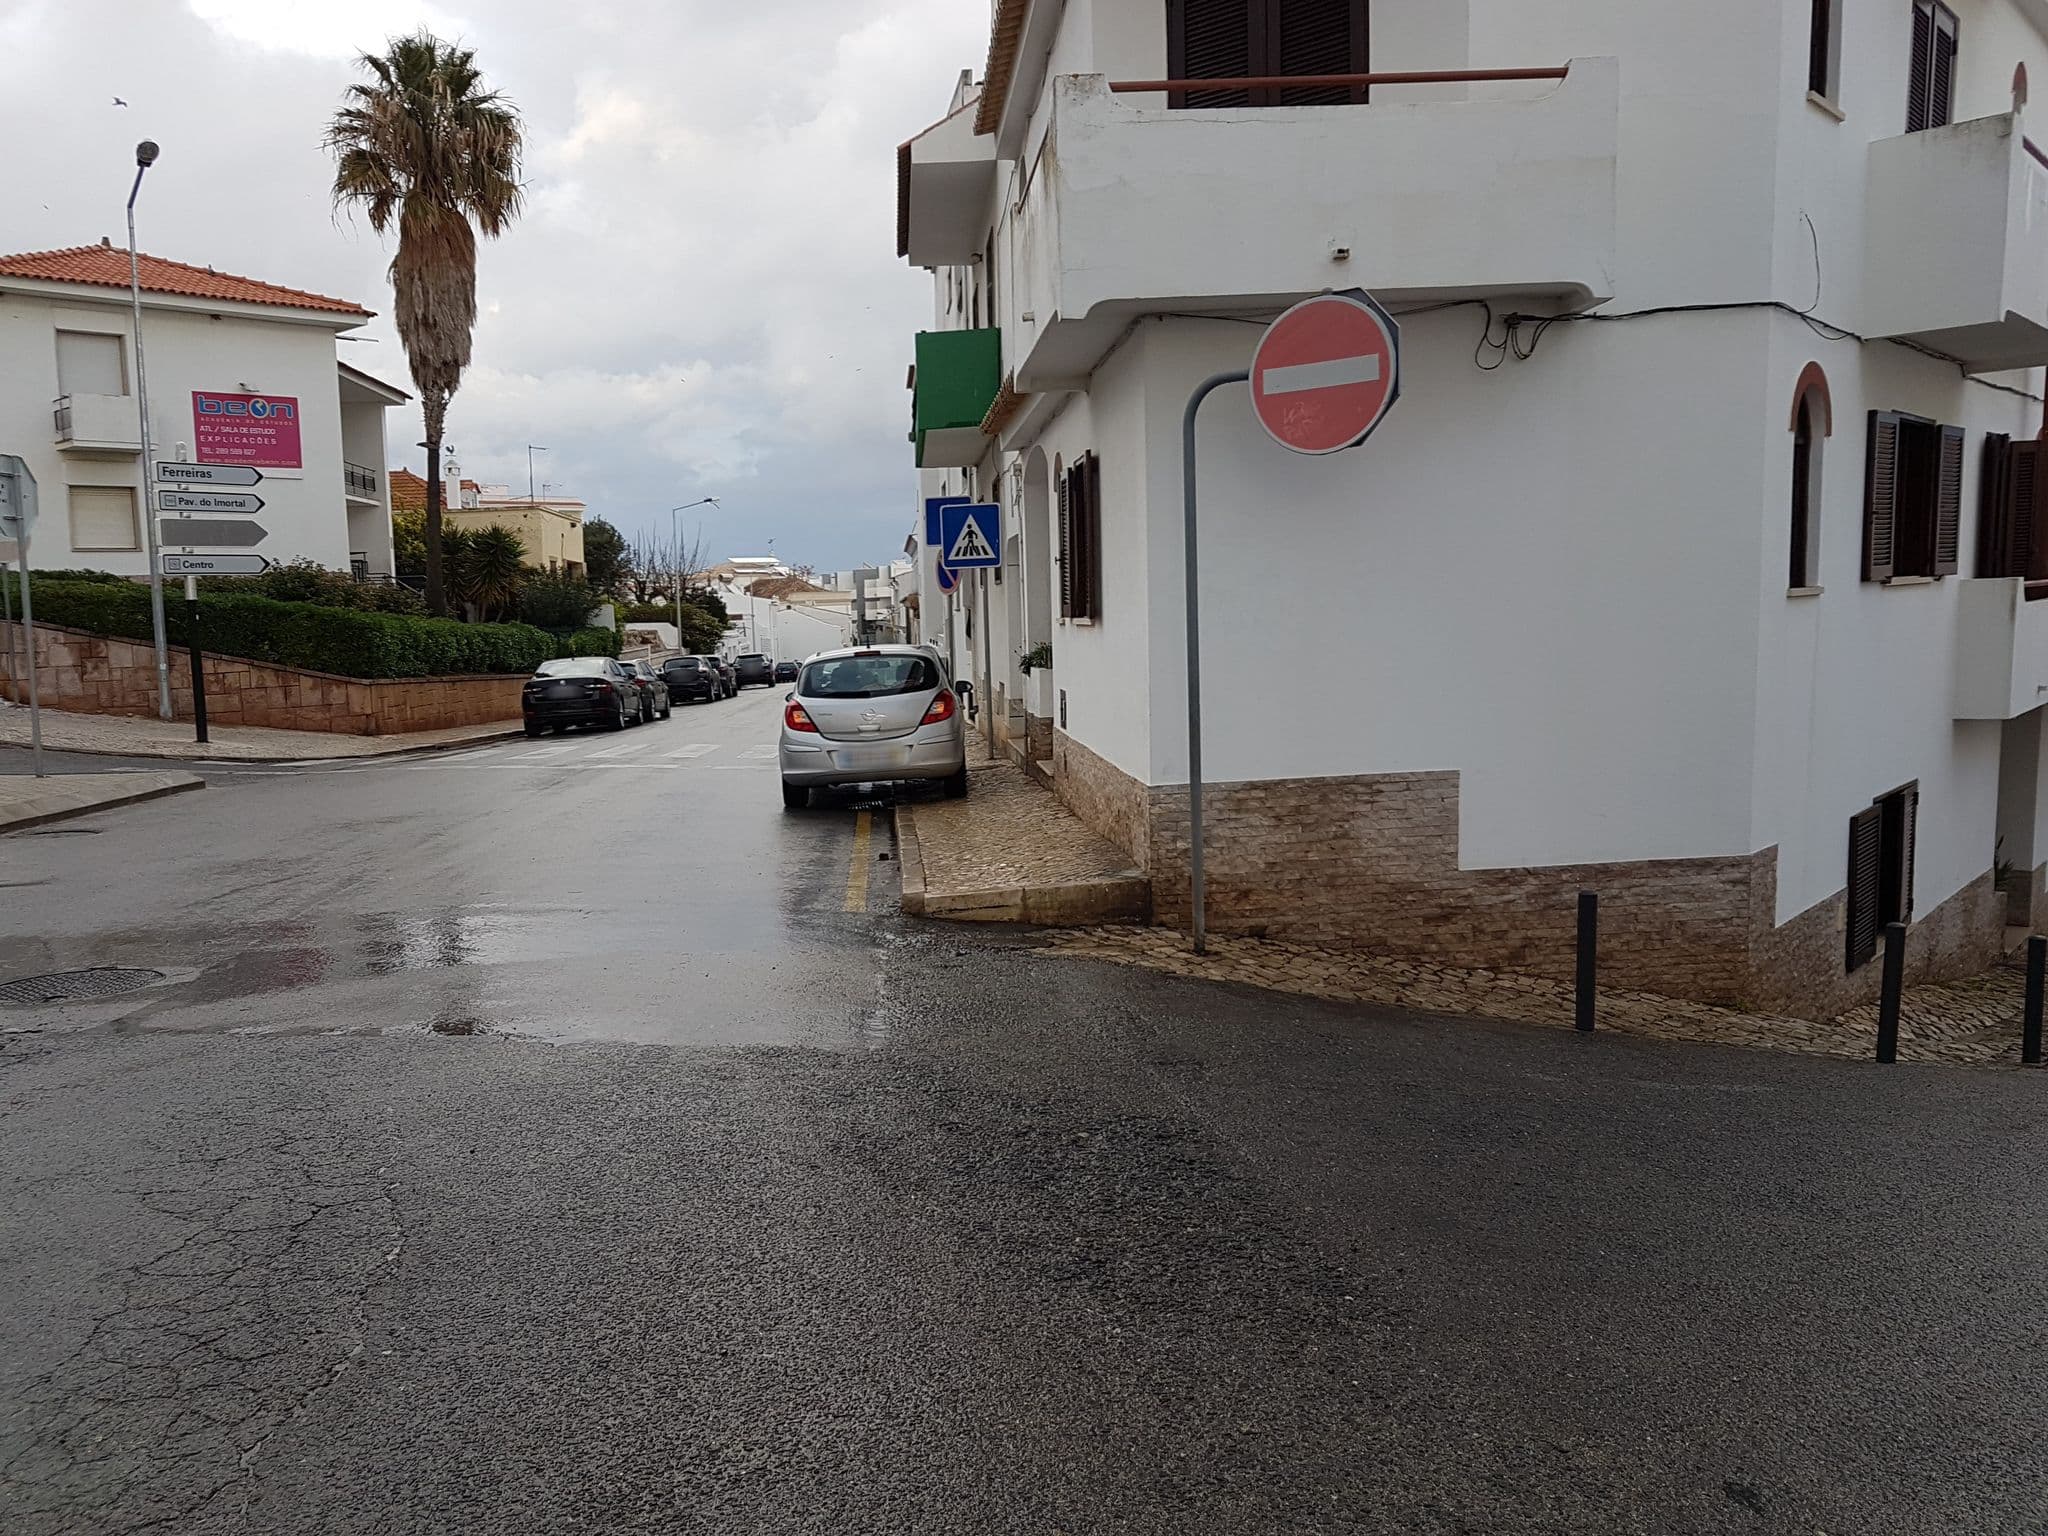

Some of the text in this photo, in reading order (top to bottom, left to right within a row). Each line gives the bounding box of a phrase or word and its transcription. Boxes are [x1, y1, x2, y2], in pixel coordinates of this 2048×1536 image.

[250, 427, 276, 435] ESTUDO
[162, 466, 212, 478] Ferreiras
[178, 497, 198, 506] Pav.
[214, 498, 246, 507] Imortal
[183, 560, 214, 569] Centro
